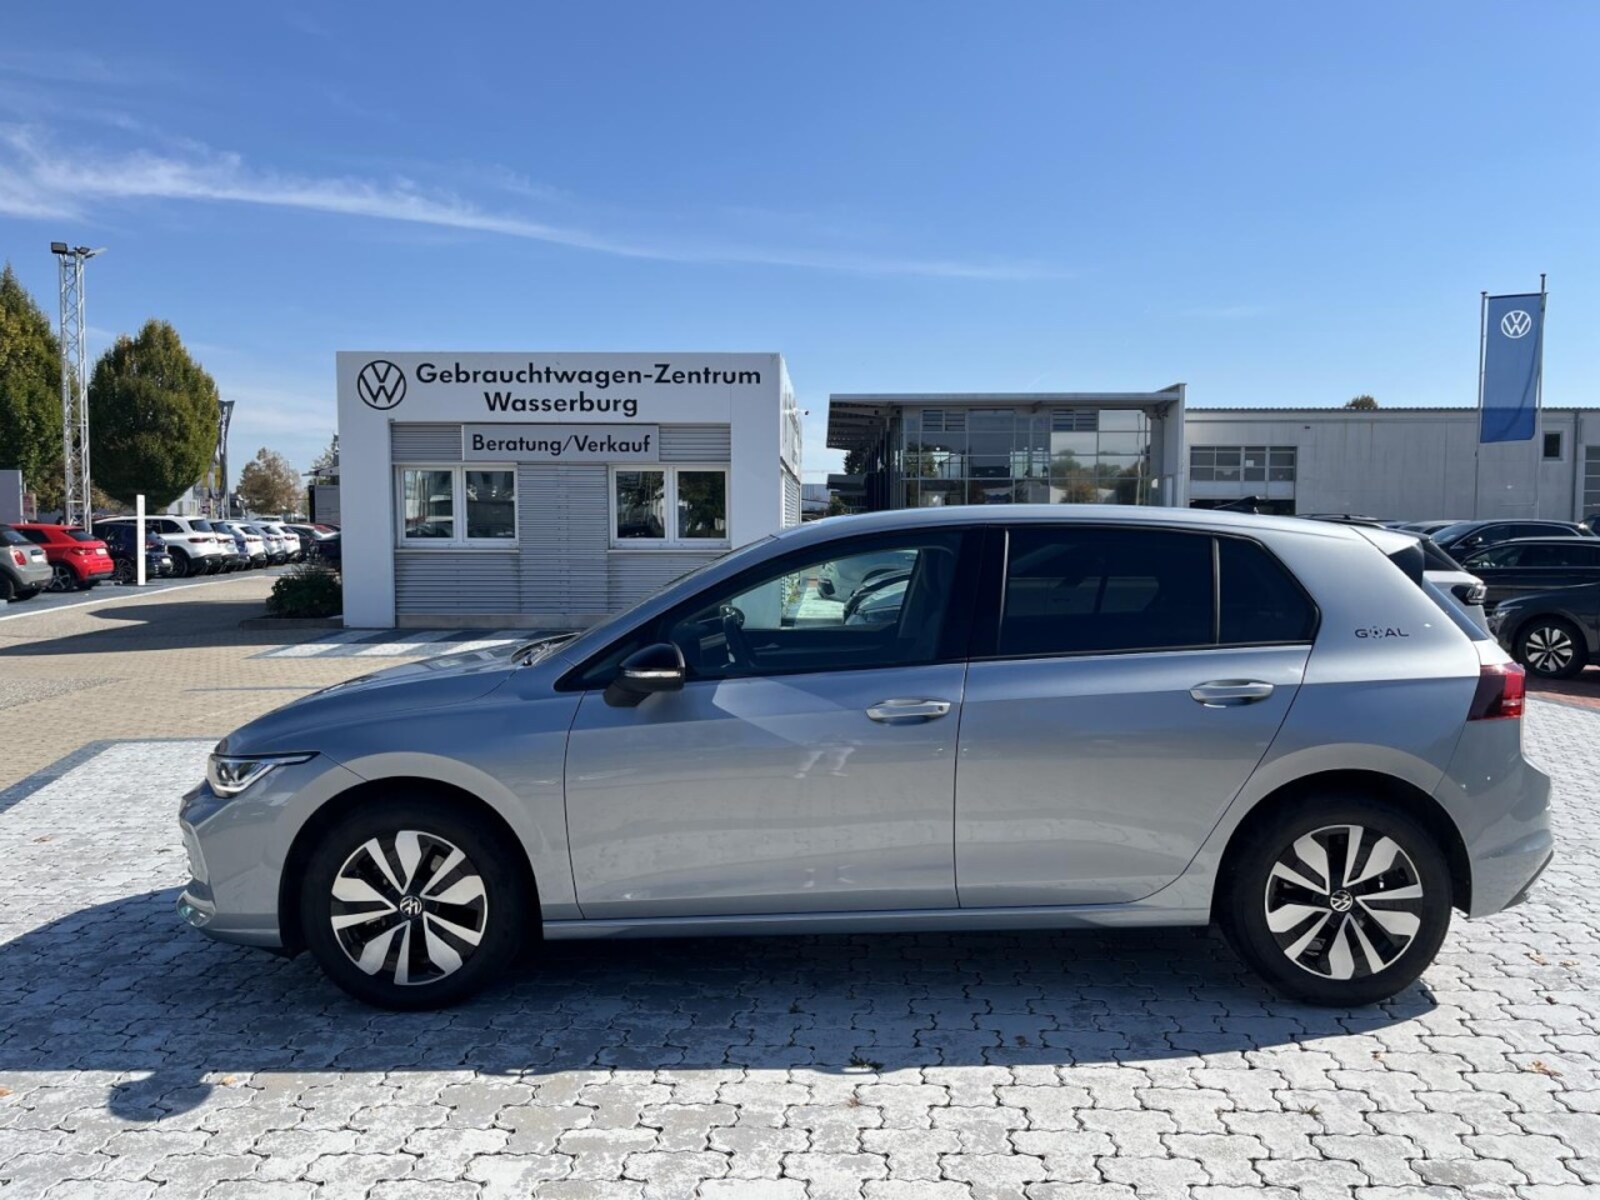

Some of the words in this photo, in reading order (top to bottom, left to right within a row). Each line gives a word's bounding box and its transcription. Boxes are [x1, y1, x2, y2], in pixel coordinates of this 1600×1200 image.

[357, 360, 407, 410] VW
[416, 362, 761, 388] Gebrauchtwagen-Zentrum
[484, 391, 638, 417] Wasserburg
[472, 434, 651, 456] Beratung/Verkauf
